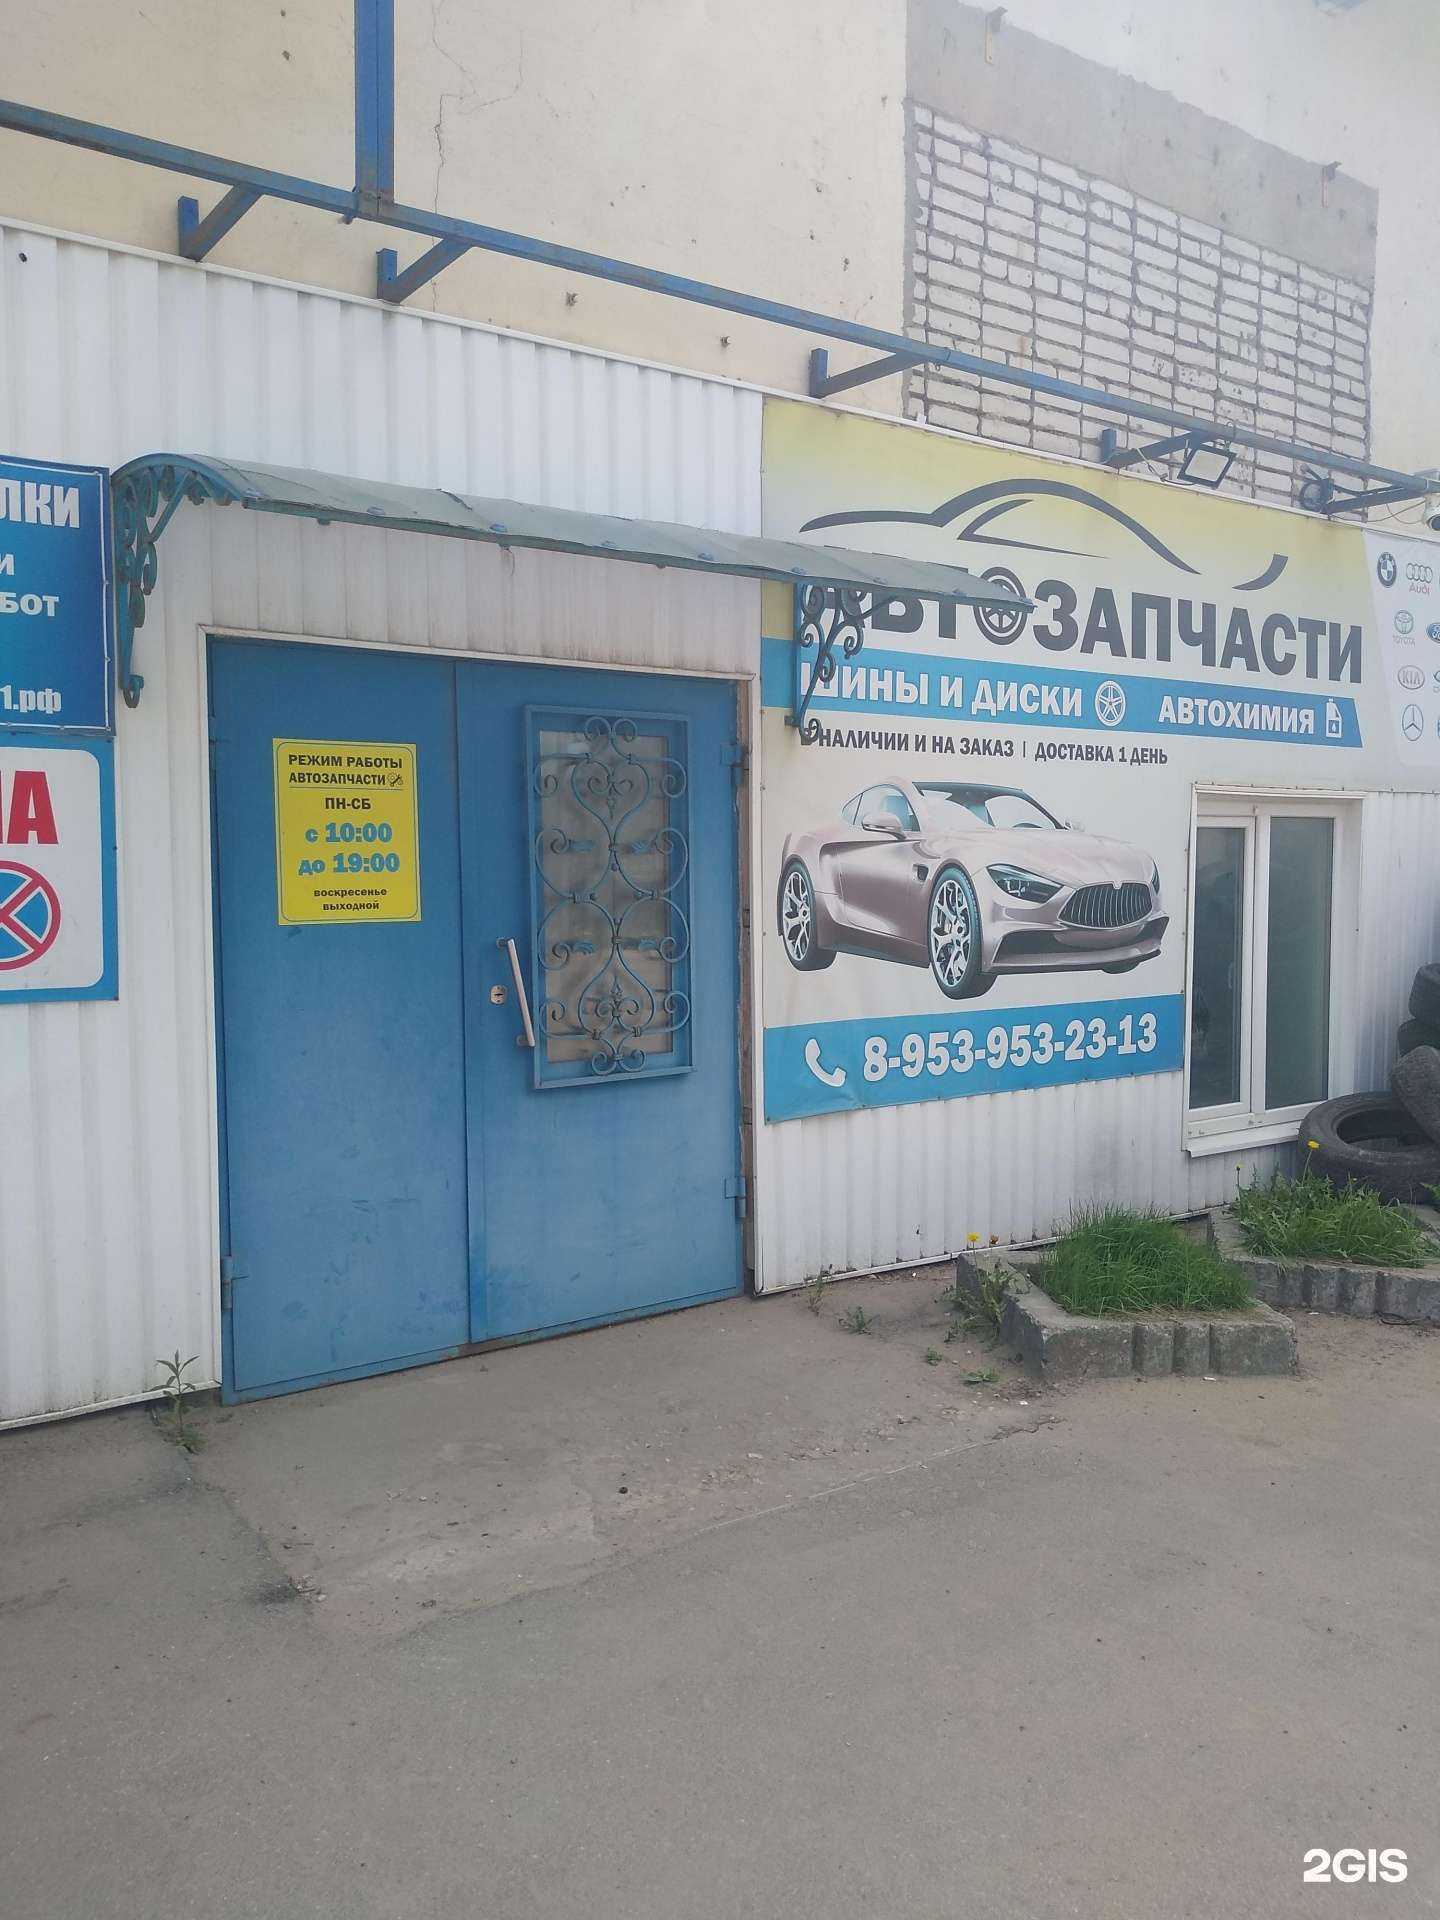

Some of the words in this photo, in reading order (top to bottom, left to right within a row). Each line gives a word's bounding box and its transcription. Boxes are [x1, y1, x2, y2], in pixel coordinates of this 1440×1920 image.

[804, 545, 1363, 684] ВТОЗАПЧАСТИ
[800, 662, 929, 706] ШИНЫ
[940, 675, 963, 708] И
[971, 679, 1082, 717] ДИСКИ
[1158, 695, 1315, 734] АВТОХИМИЯ
[819, 728, 909, 752] НАЛИЧИИ
[914, 734, 927, 753] И
[932, 735, 955, 754] НА
[959, 737, 1014, 757] ЗАКАЗ
[1034, 742, 1114, 763] ДОСТАВКА
[1118, 747, 1128, 763] 1
[1130, 747, 1168, 766] ДЕНЬ
[288, 754, 342, 767] РЕЖИМ
[346, 756, 403, 769] РАБОТЫ
[288, 772, 386, 786] АВТОЗАПЧАСТИ
[0, 770, 59, 845] А
[325, 797, 371, 810] ПН-СБ
[325, 822, 393, 843] 10:00
[298, 859, 325, 876] до
[333, 852, 400, 873] 19:00
[313, 888, 387, 899] воскресенье
[322, 900, 379, 911] выходной
[863, 1012, 1157, 1082] 8-953-953-23-13
